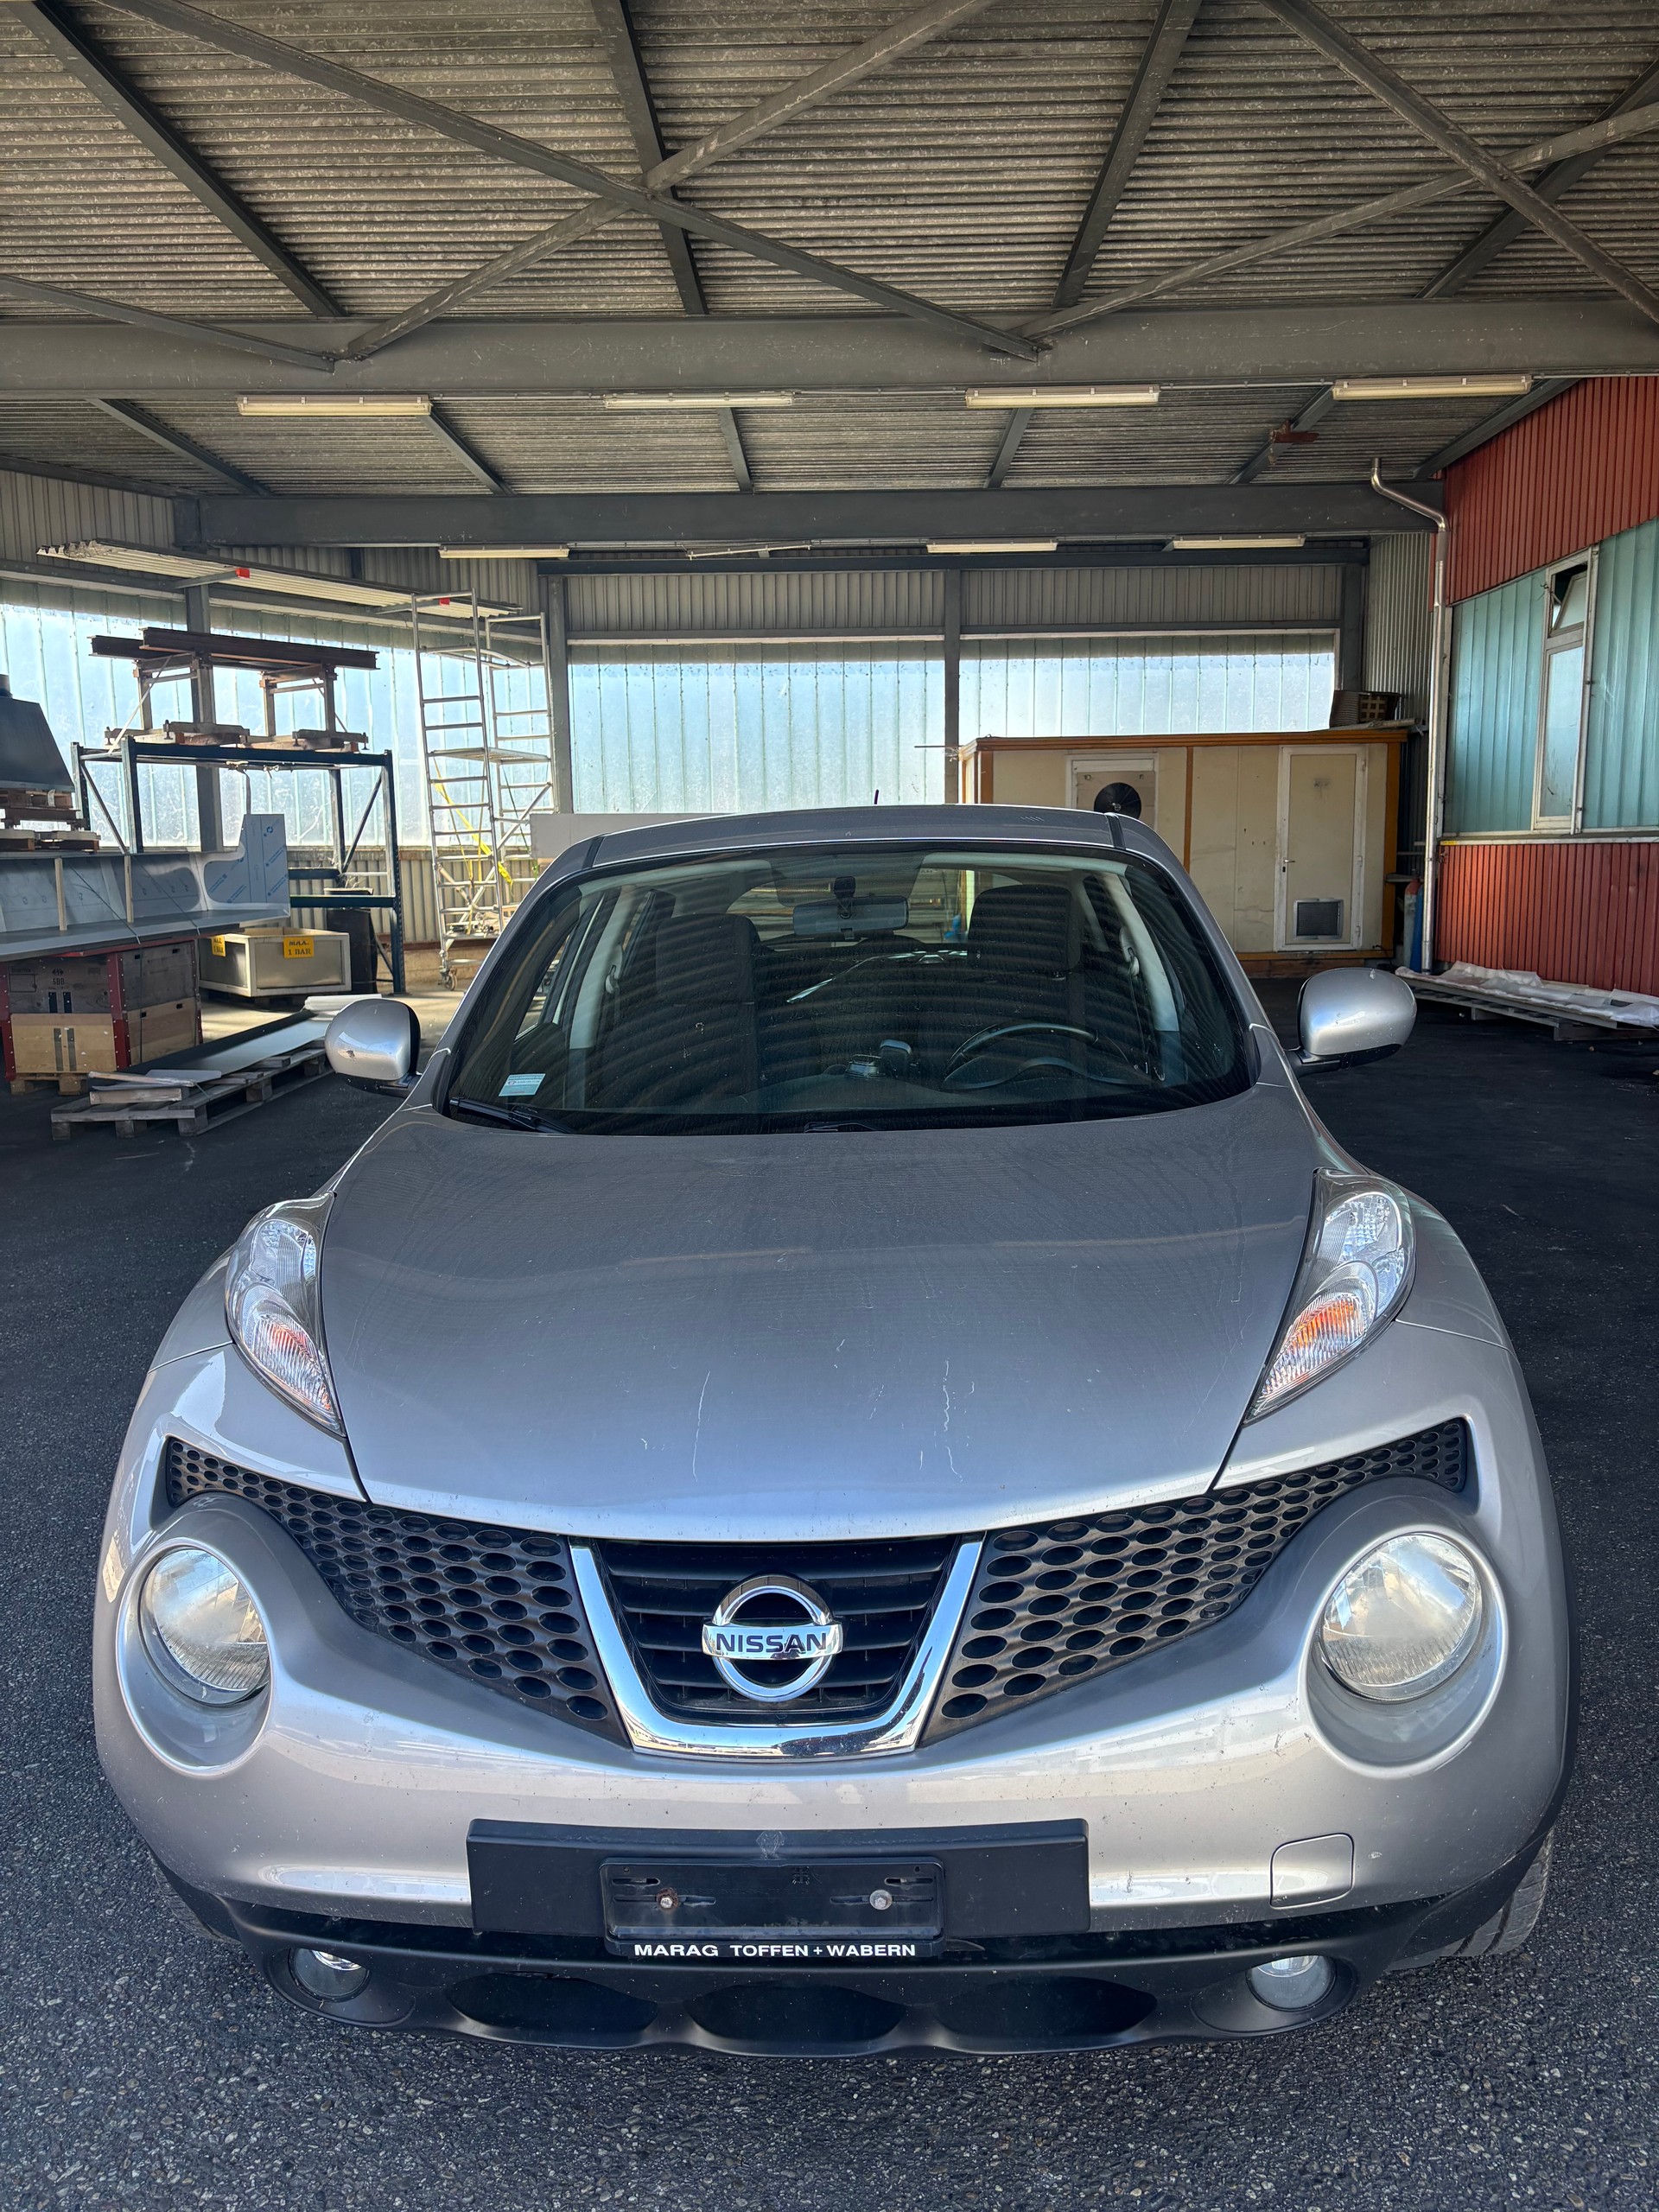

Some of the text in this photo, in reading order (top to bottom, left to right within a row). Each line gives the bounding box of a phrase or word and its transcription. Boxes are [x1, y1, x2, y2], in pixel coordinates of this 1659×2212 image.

[715, 1631, 827, 1654] NISSAN
[633, 1944, 719, 1957] MARAG
[729, 1944, 809, 1957] TOFFEN
[826, 1944, 916, 1957] WABERN
